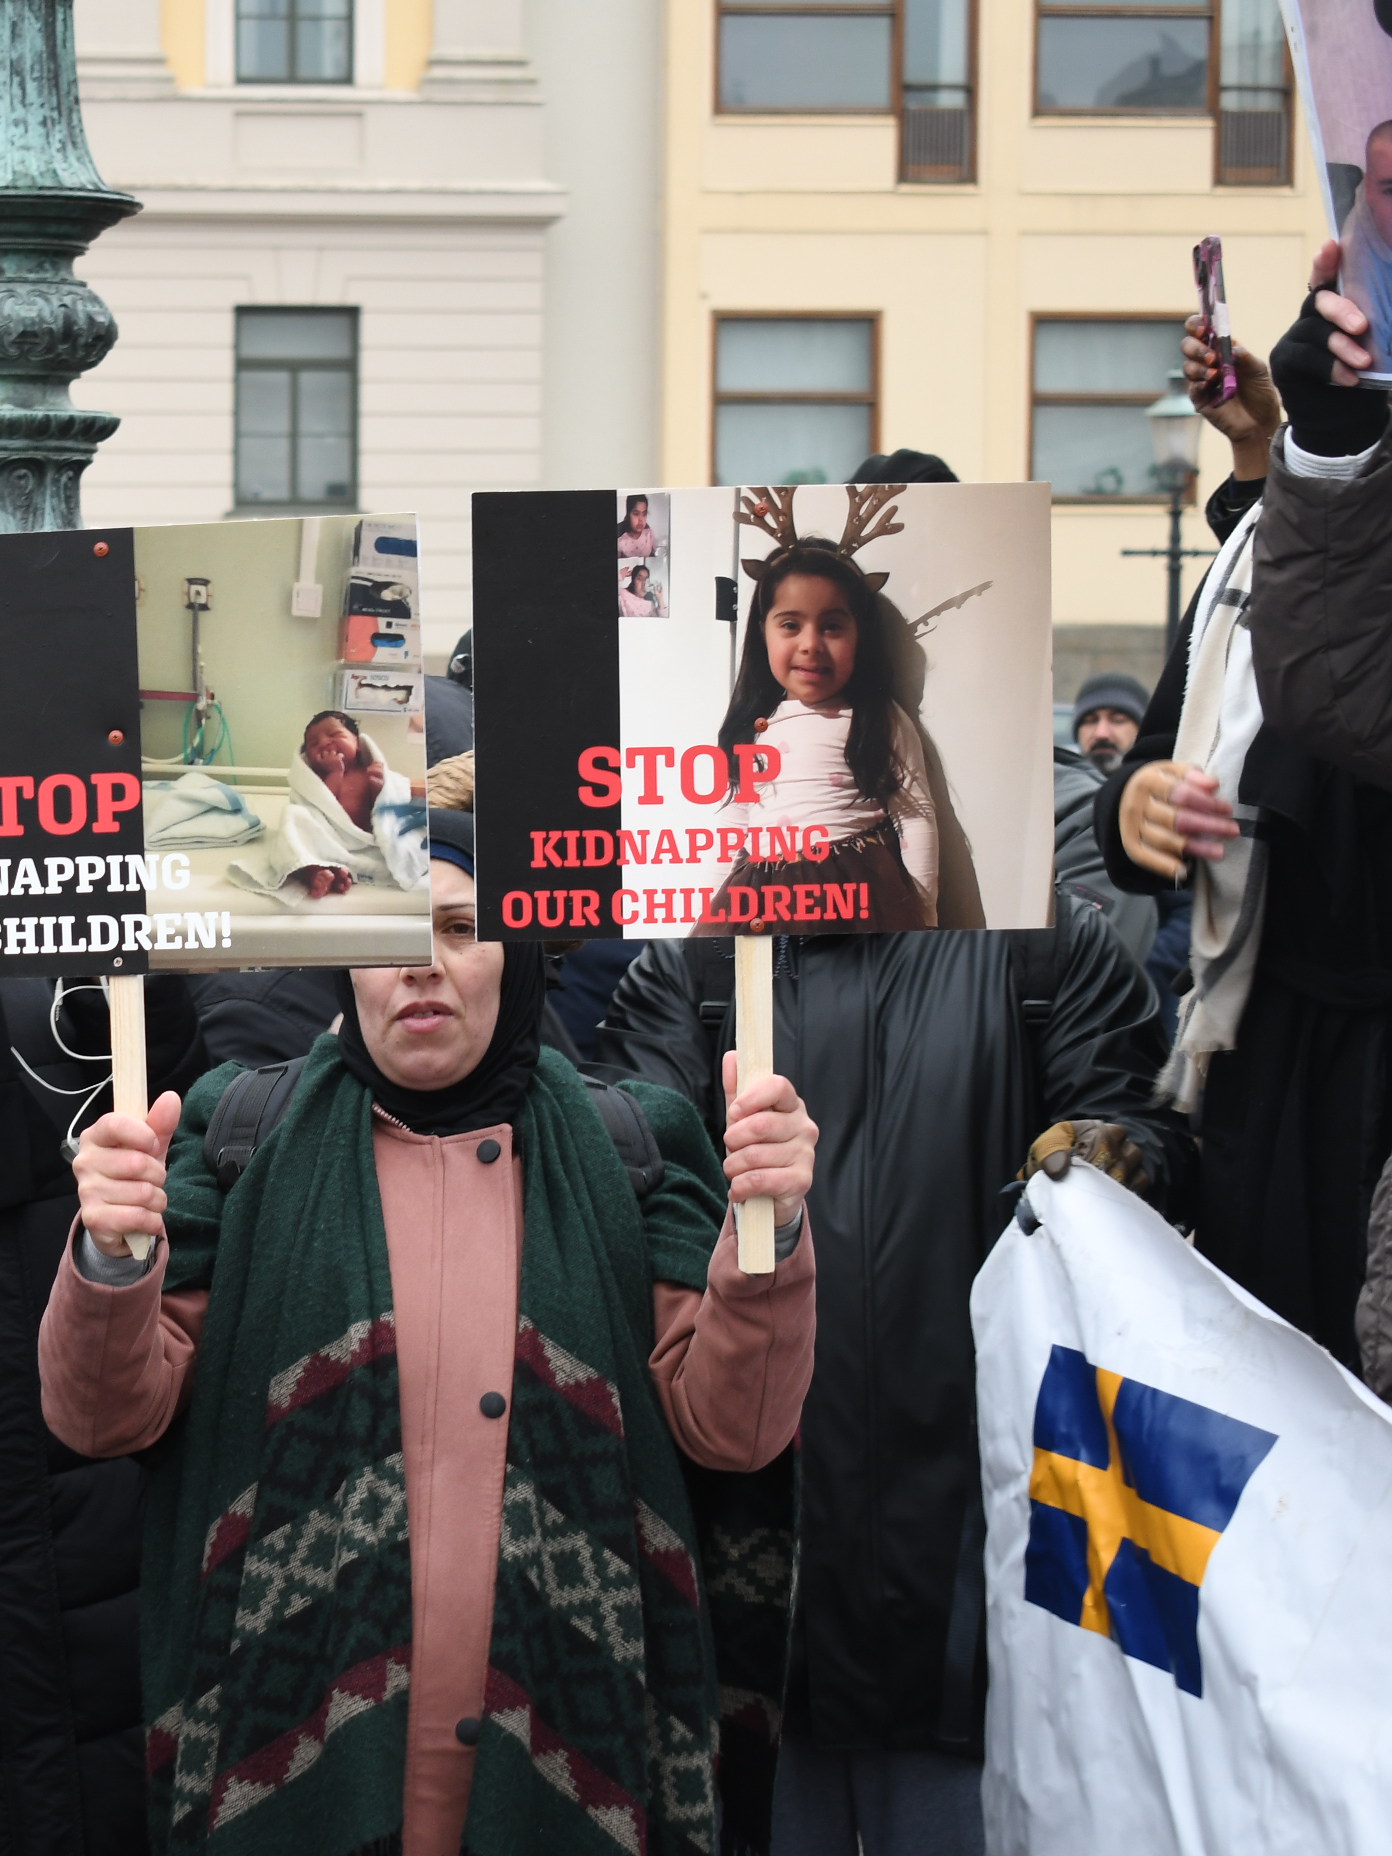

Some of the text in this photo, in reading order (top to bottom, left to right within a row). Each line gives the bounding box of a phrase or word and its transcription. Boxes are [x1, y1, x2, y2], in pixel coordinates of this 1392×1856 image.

[577, 744, 782, 808] STOP
[529, 824, 831, 869] KIDNAPPING
[501, 881, 870, 929] OUR CHILDREN!
